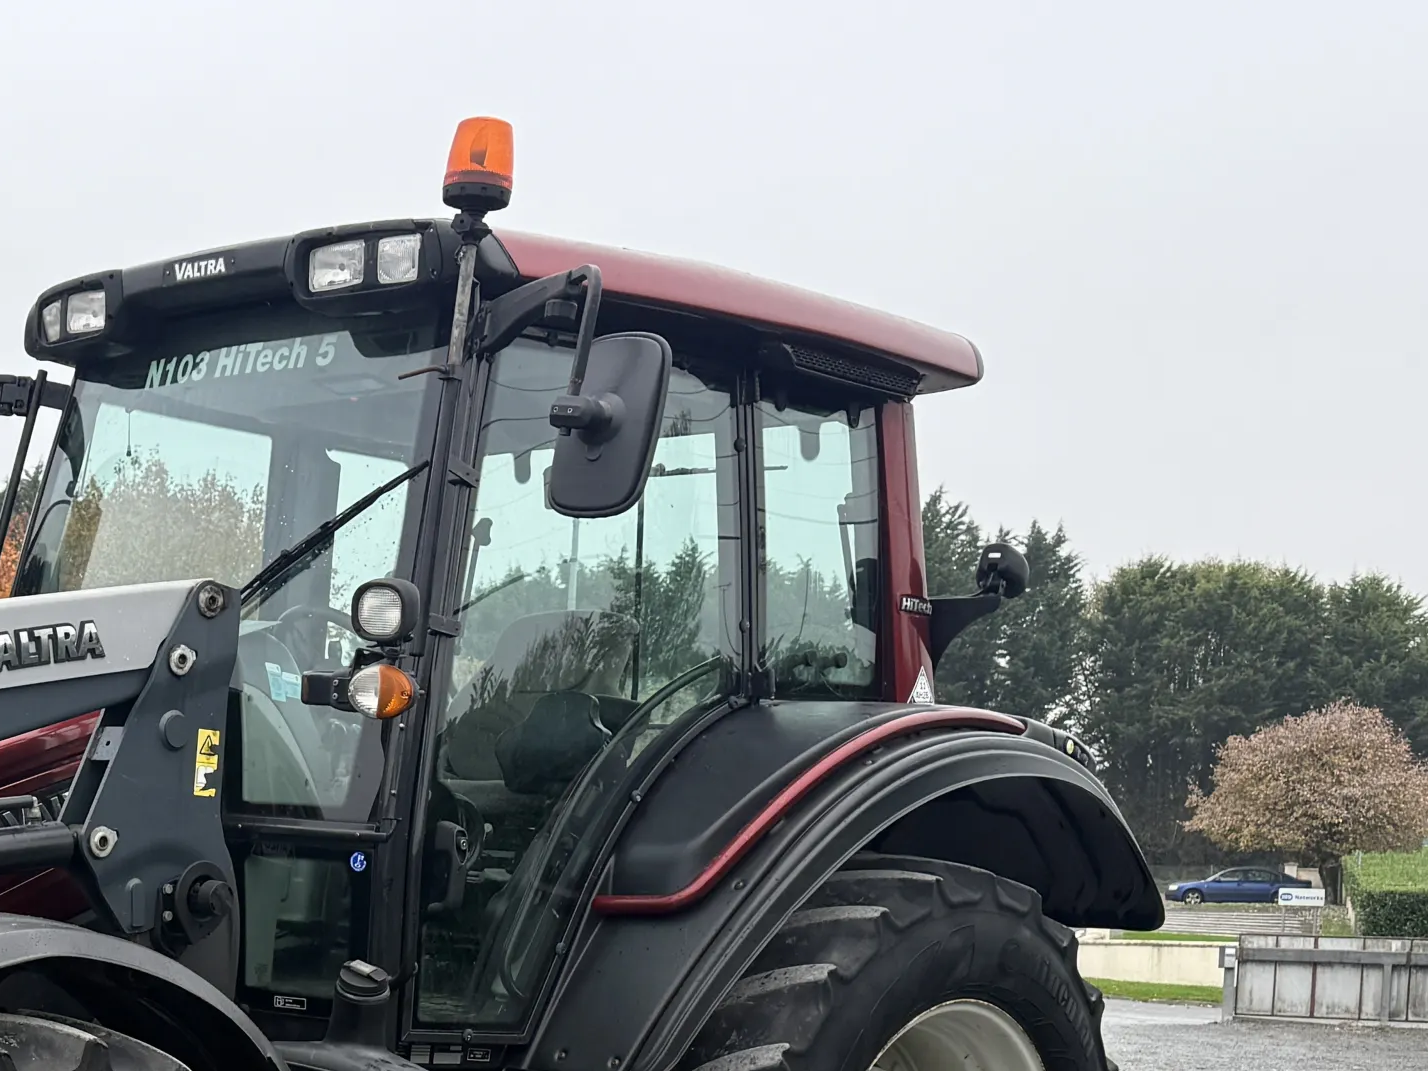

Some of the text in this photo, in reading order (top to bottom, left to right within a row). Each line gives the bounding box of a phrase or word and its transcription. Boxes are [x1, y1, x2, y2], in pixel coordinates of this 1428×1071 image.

[174, 257, 226, 281] VALTRA
[144, 335, 338, 390] N103 HiTech 5
[901, 597, 933, 615] HiTech
